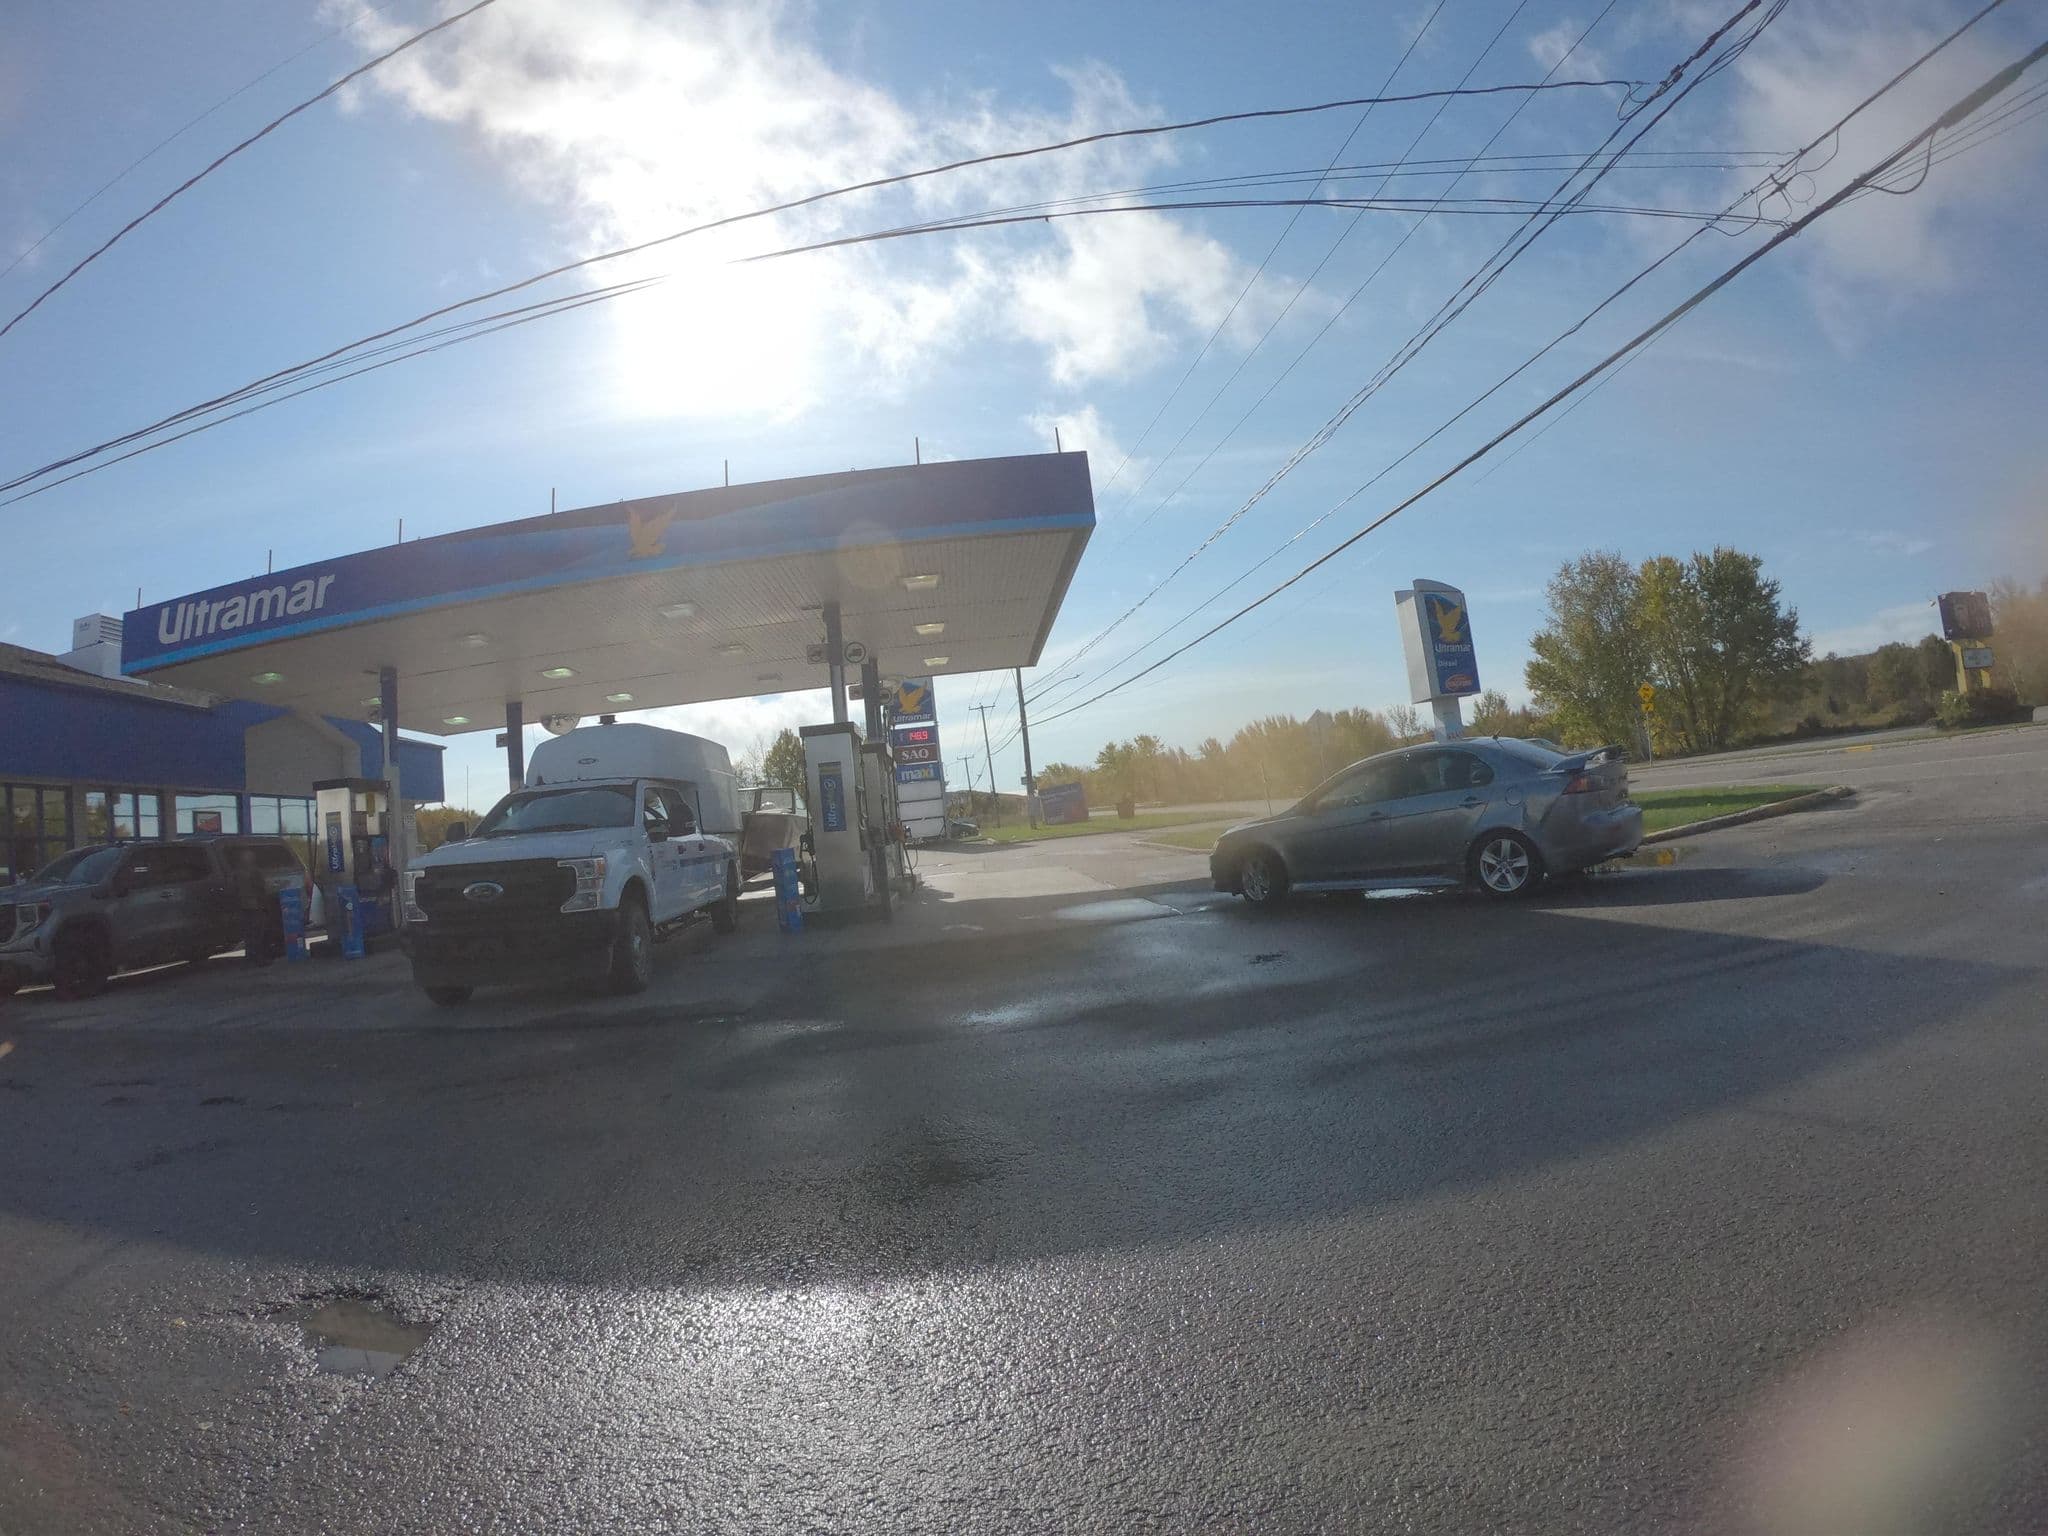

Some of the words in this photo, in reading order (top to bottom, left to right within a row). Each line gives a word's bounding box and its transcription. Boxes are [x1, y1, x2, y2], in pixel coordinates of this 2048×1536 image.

[158, 574, 336, 645] Ultramar
[1435, 643, 1472, 653] Ultramar
[893, 712, 932, 723] Ultramar
[902, 748, 929, 761] SAQ
[901, 764, 934, 781] maxi
